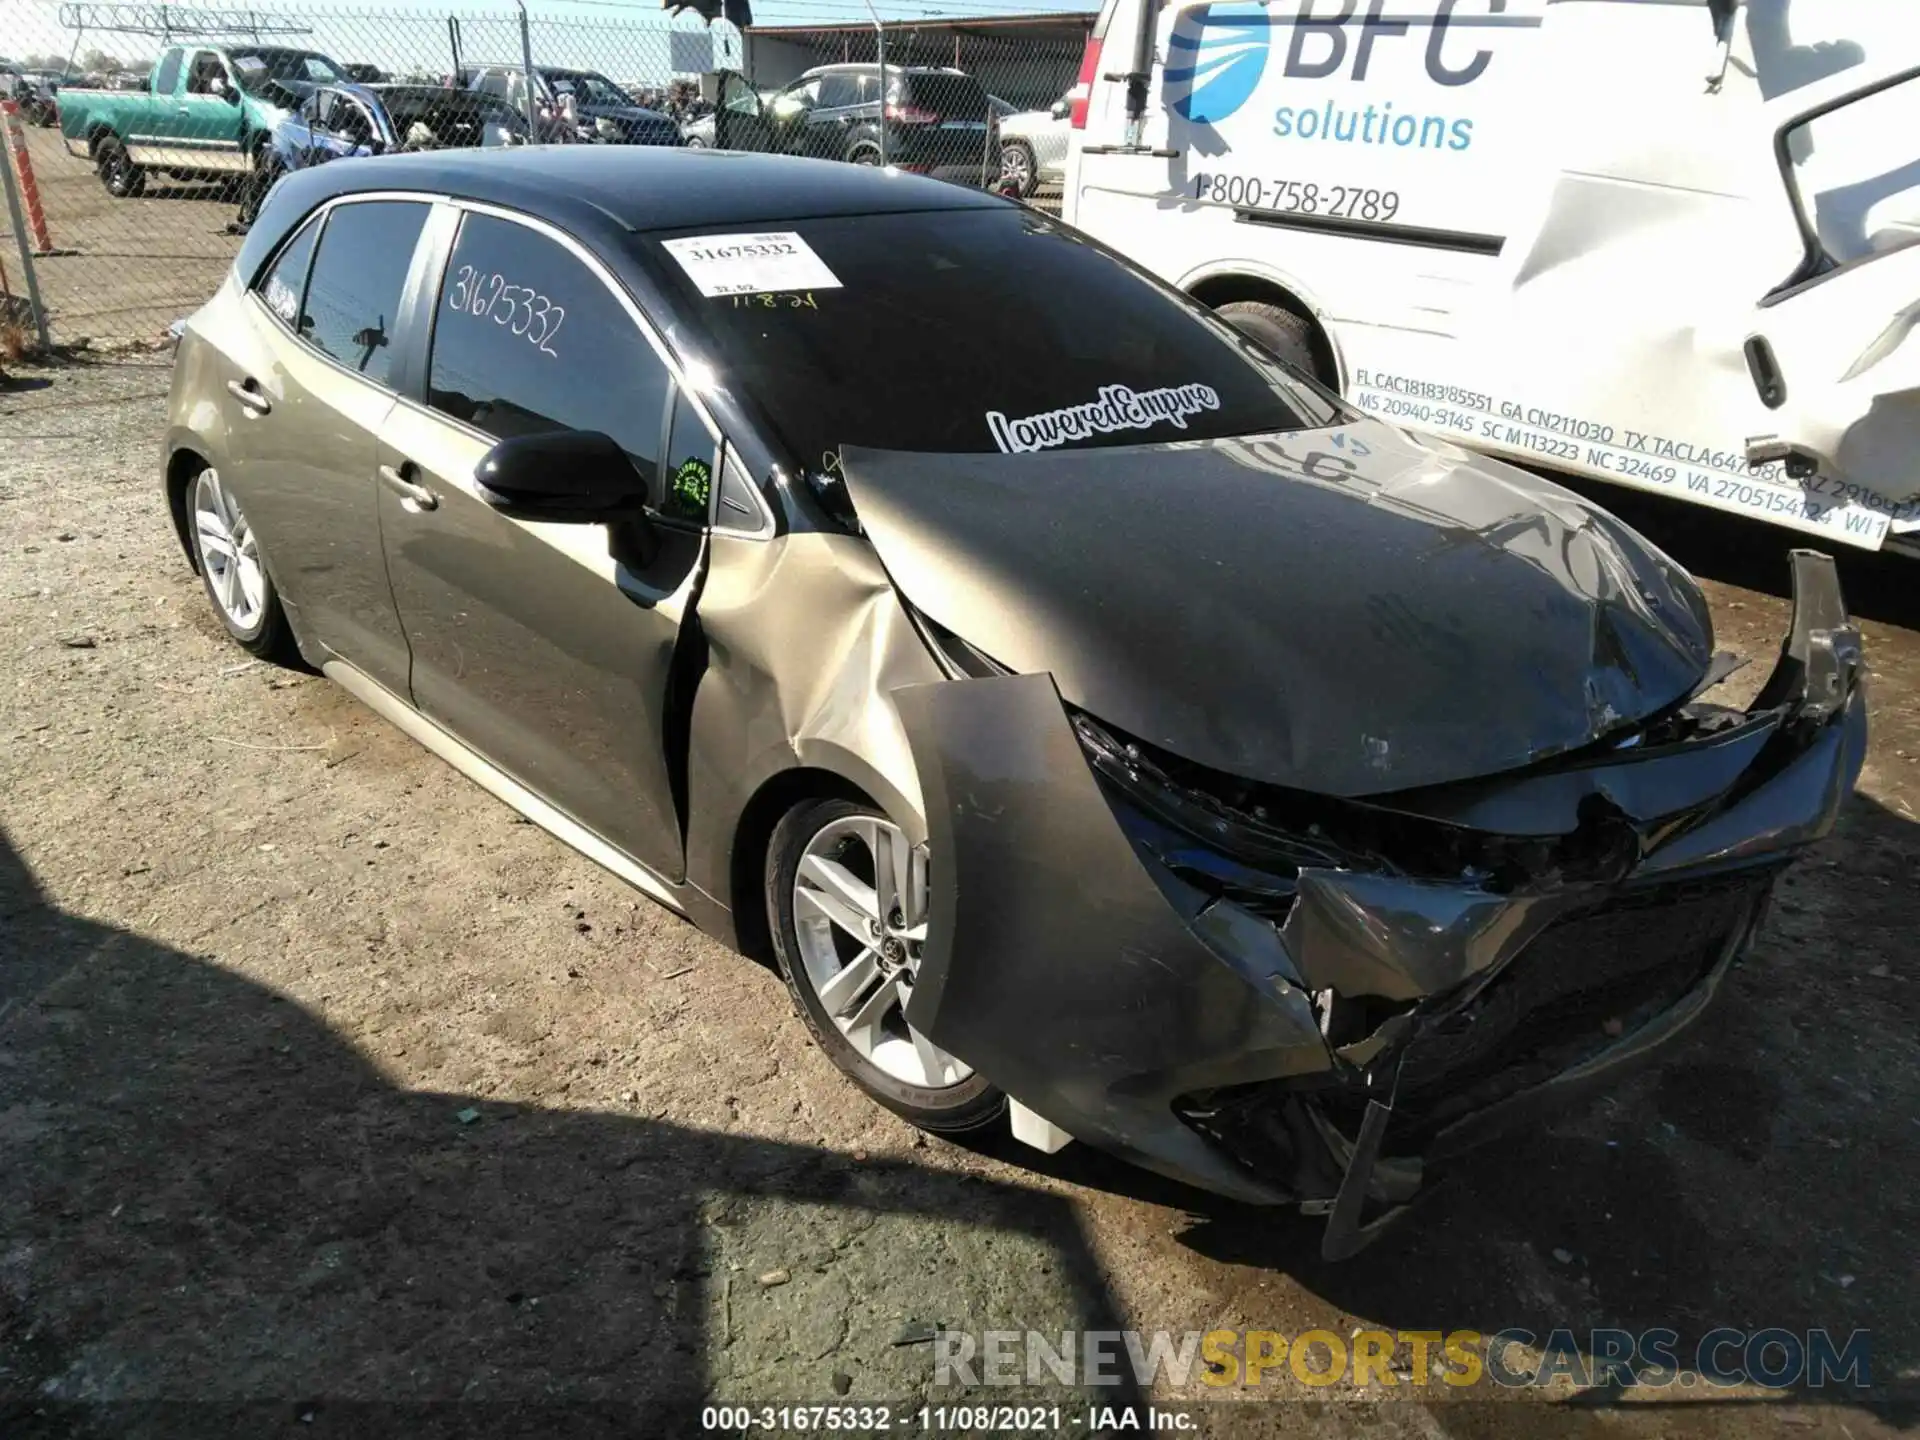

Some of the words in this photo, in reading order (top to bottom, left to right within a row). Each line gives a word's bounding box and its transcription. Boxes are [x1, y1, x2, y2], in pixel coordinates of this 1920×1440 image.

[1283, 0, 1506, 87] BFC
[1273, 100, 1474, 151] solutions
[1195, 172, 1400, 222] 1-800-758-2789
[690, 243, 799, 261] 31675332
[450, 265, 566, 358] 31675332
[1356, 368, 1372, 387] FL
[1500, 401, 1523, 421] GA
[1527, 408, 1615, 443] CN211030
[1623, 430, 1648, 451] TX
[1357, 391, 1380, 411] MS
[1480, 420, 1504, 441] SC
[1504, 428, 1580, 461] M113223
[1586, 448, 1614, 470] NC
[1616, 455, 1677, 484] 32469
[1687, 472, 1710, 495] VA
[1844, 511, 1872, 535] WI
